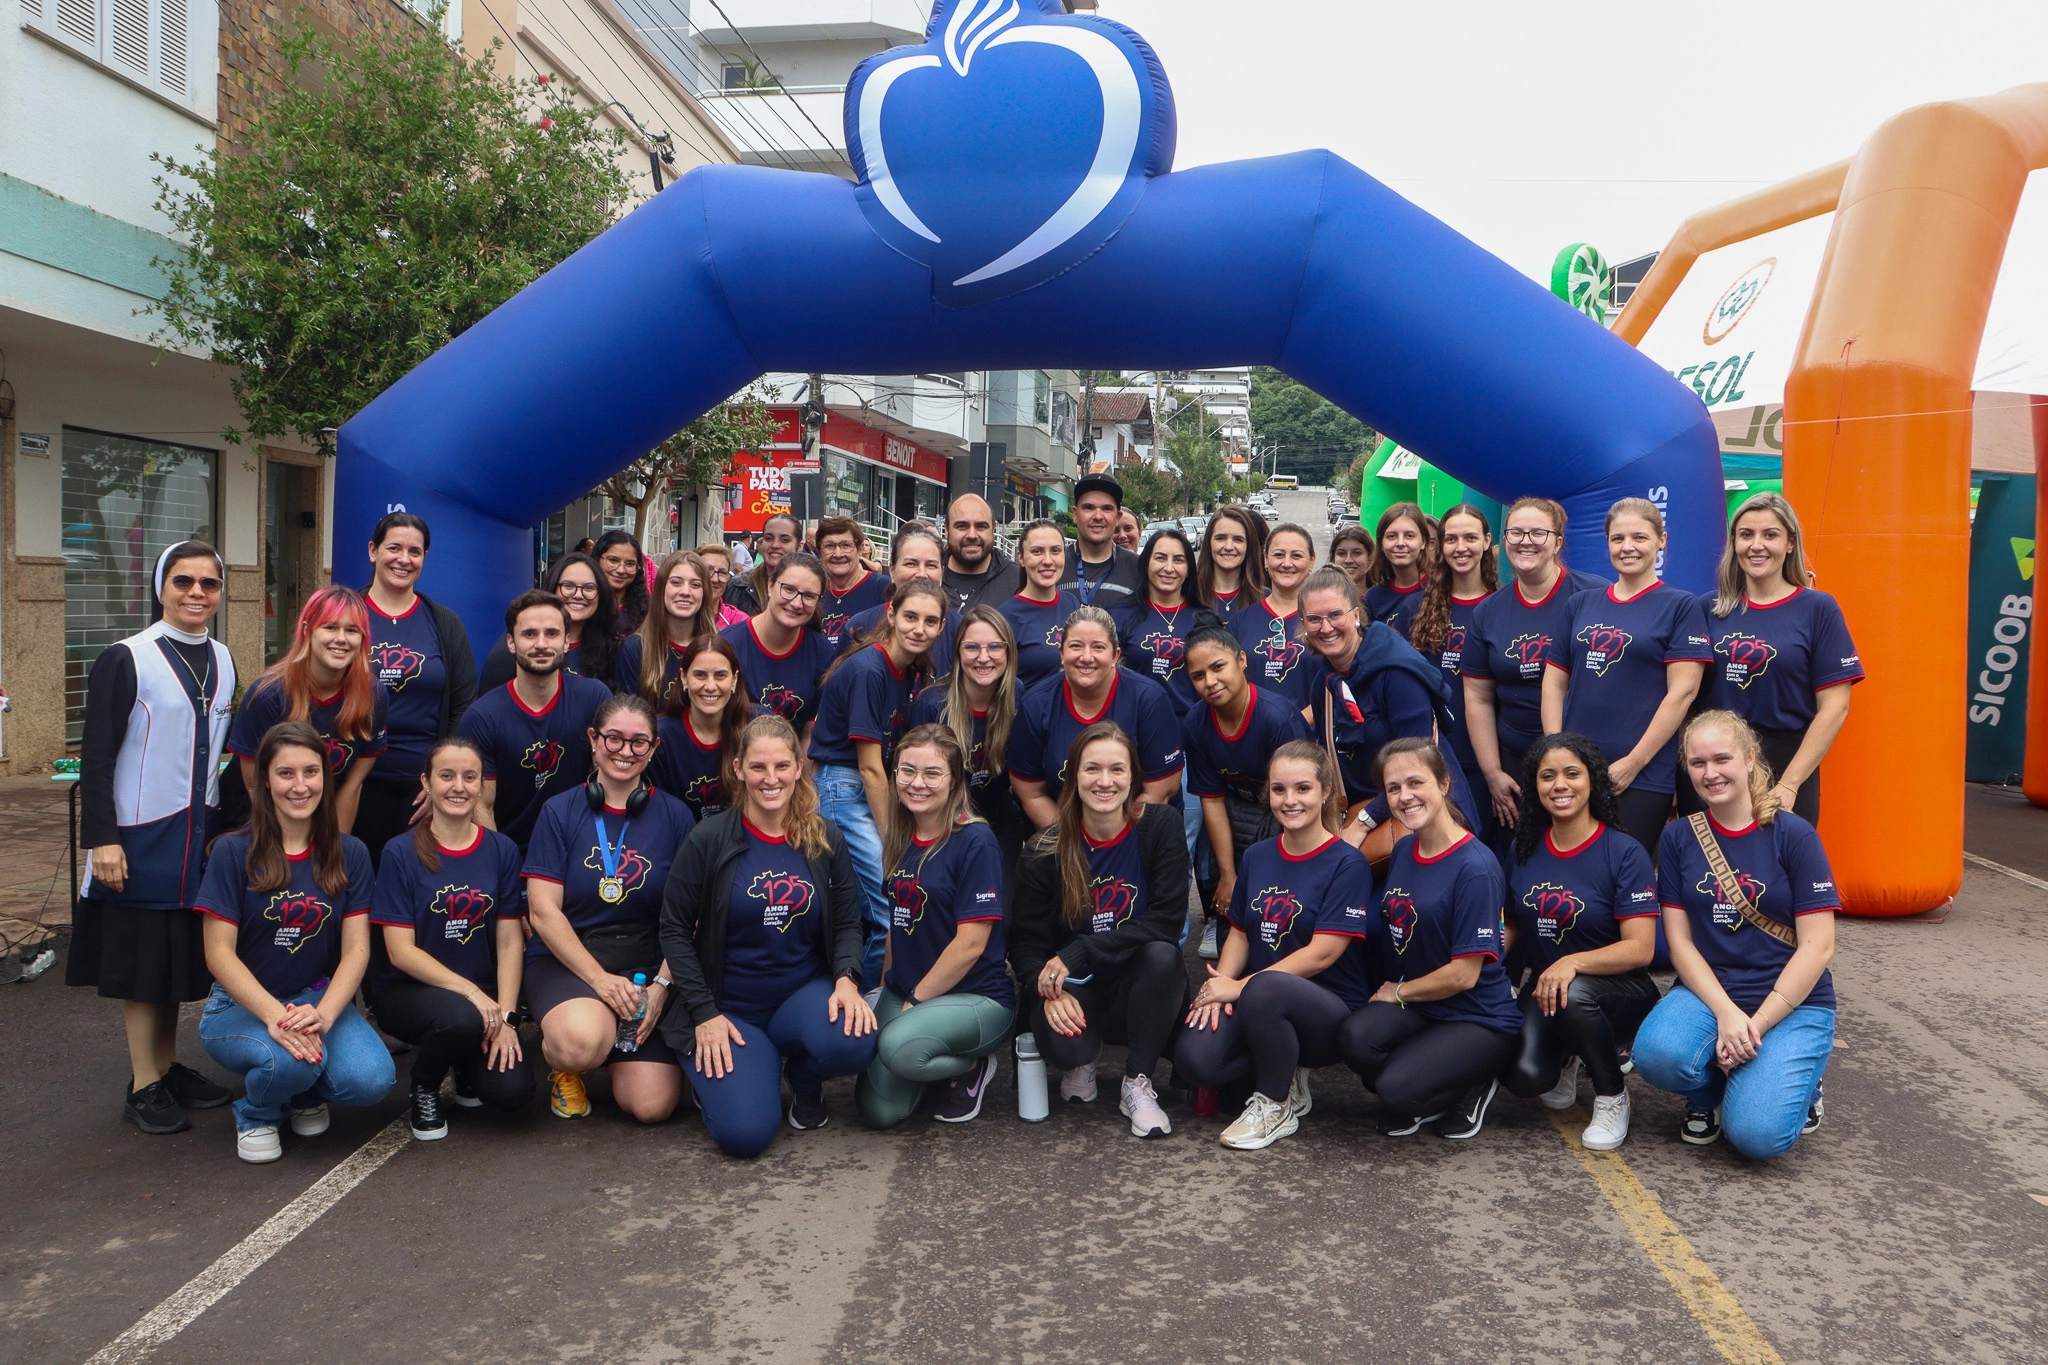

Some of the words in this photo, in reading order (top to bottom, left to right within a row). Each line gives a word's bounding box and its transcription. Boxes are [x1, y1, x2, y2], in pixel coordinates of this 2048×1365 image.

[1668, 351, 1755, 407] SOL
[886, 438, 916, 468] BENOIT
[751, 501, 791, 514] CASA
[1152, 638, 1184, 666] 125
[1267, 640, 1298, 667] 125
[1444, 630, 1468, 653] 12
[1589, 628, 1625, 659] 125
[1729, 639, 1769, 671] 125
[379, 647, 419, 675] 125
[1969, 594, 2033, 727] SICOOB
[768, 690, 798, 718] 25
[599, 849, 644, 885] 25
[763, 875, 809, 912] 125
[893, 879, 922, 916] 125
[1091, 878, 1131, 918] 125
[1631, 891, 1653, 900] Sagrado
[1713, 873, 1757, 903] 15
[280, 896, 323, 933] 125
[445, 889, 486, 925] 125
[1092, 912, 1114, 920] ANOS
[1263, 893, 1296, 931] 125
[1537, 890, 1576, 925] 125
[1537, 917, 1557, 925] ANOS
[1260, 921, 1278, 929] ANOS
